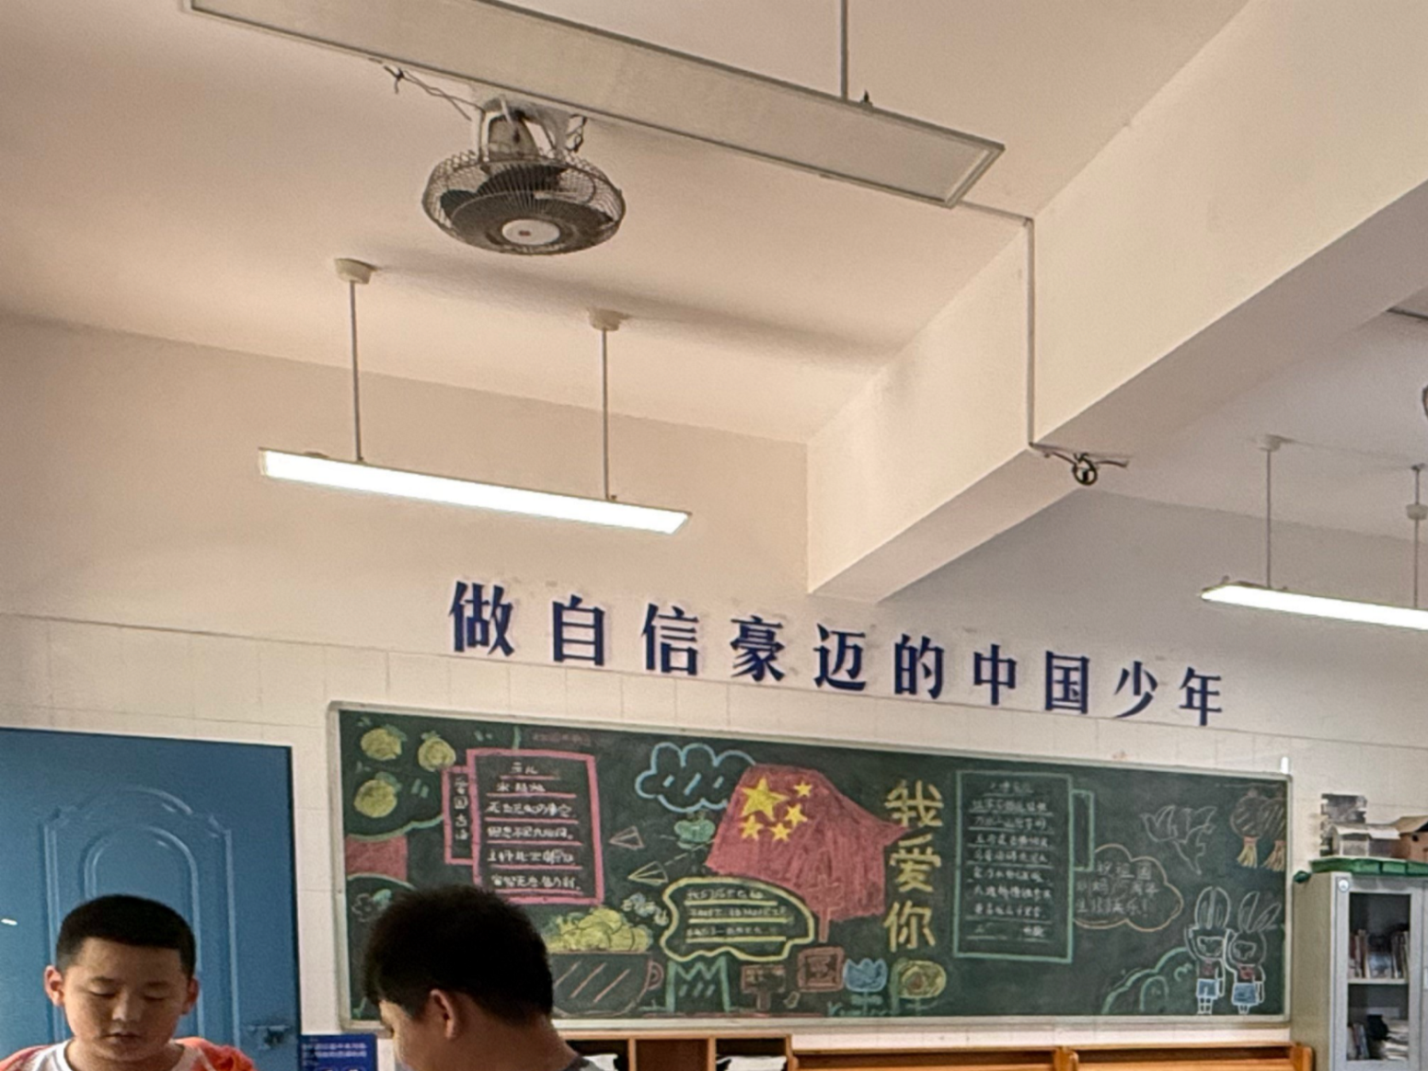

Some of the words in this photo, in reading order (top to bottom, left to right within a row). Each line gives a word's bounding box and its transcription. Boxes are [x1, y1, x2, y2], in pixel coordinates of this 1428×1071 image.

[449, 580, 1222, 727] 做自信豪迈的中国少年
[884, 779, 944, 952] 我爱你
